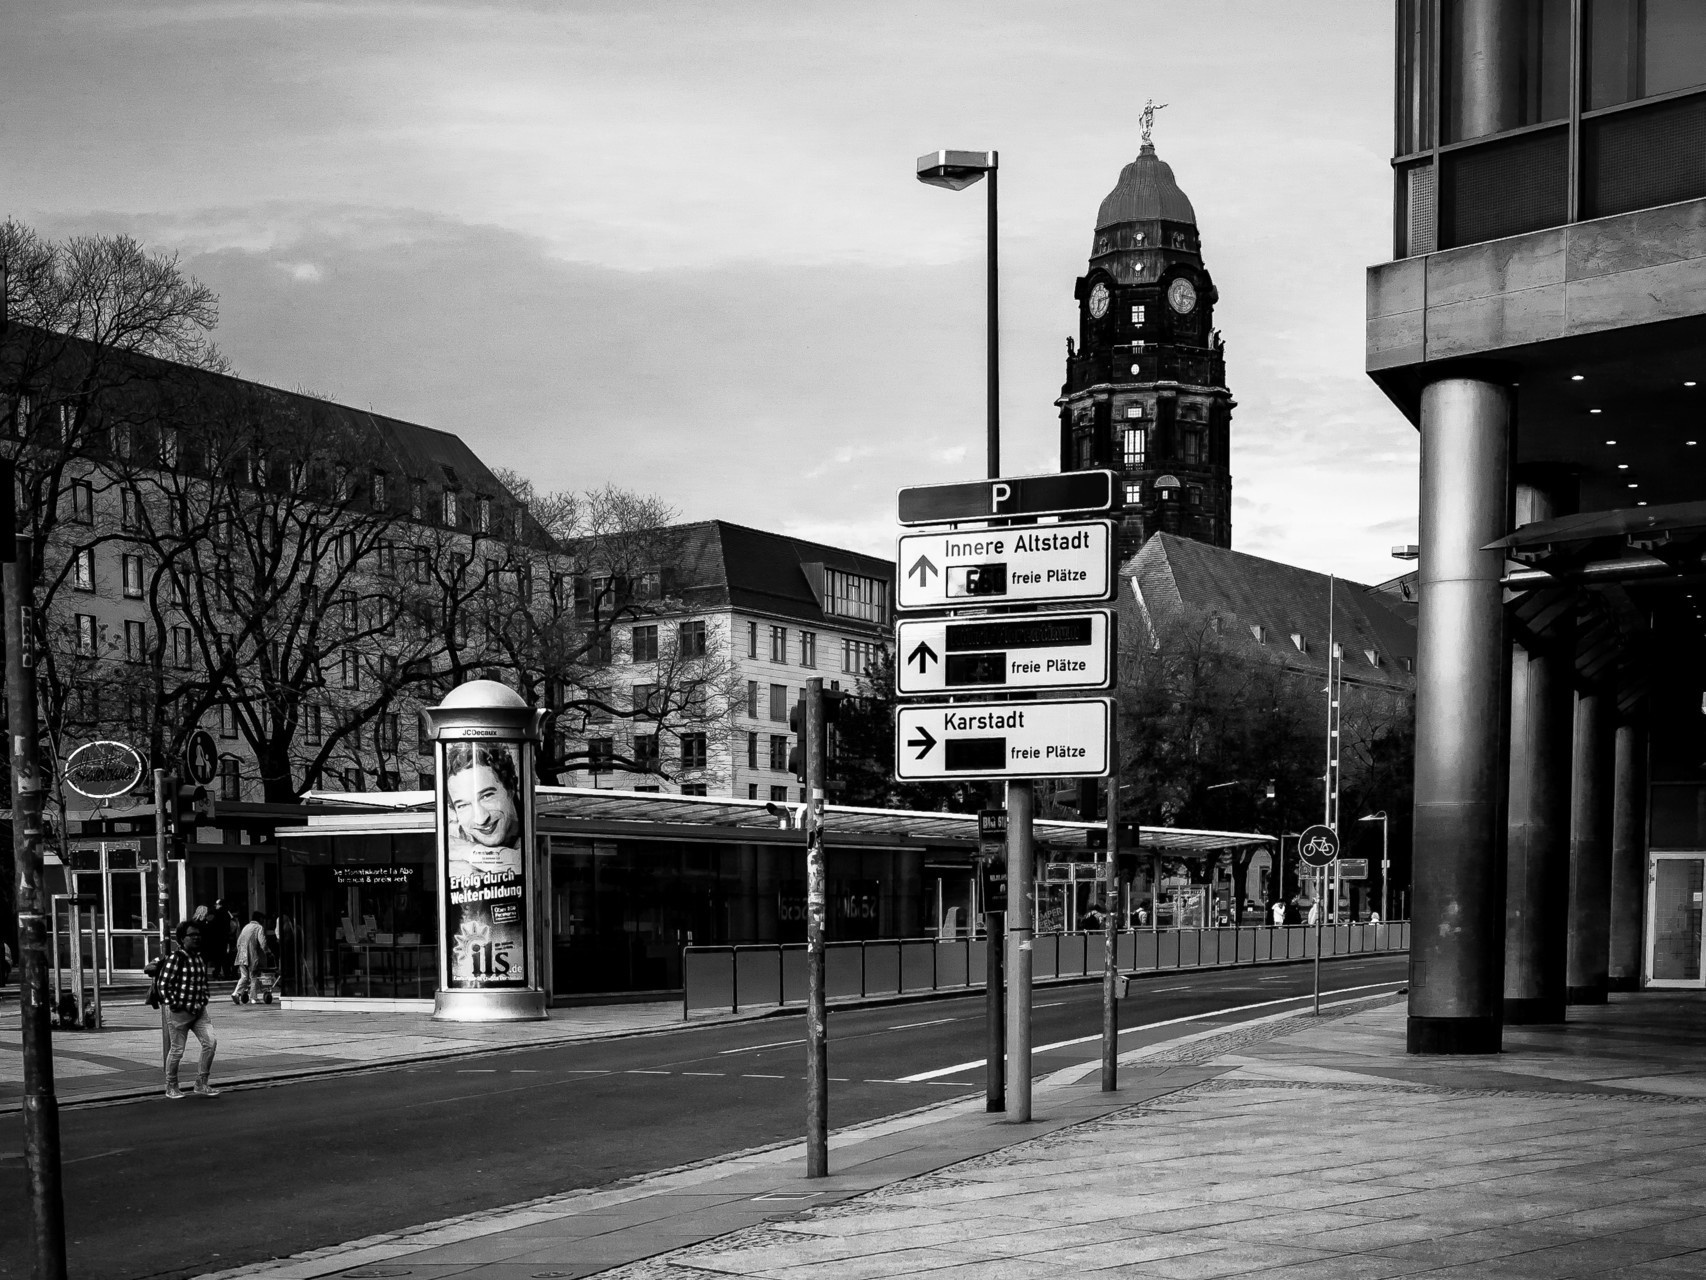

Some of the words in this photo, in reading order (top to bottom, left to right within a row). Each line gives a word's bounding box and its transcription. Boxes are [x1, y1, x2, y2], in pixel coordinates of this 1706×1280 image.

[992, 484, 1011, 513] P
[945, 539, 1004, 558] Innere
[1014, 531, 1089, 553] Altstadt
[1012, 570, 1042, 584] freie
[1047, 569, 1087, 583] Plätze
[1012, 661, 1041, 674] freie
[1047, 659, 1086, 672] Plätze
[945, 711, 1024, 731] Karstadt
[1011, 747, 1041, 760] freie
[1046, 745, 1086, 758] Plätze
[451, 873, 480, 890] Erfolg
[484, 870, 514, 885] durch
[450, 886, 522, 905] Weiterbildung
